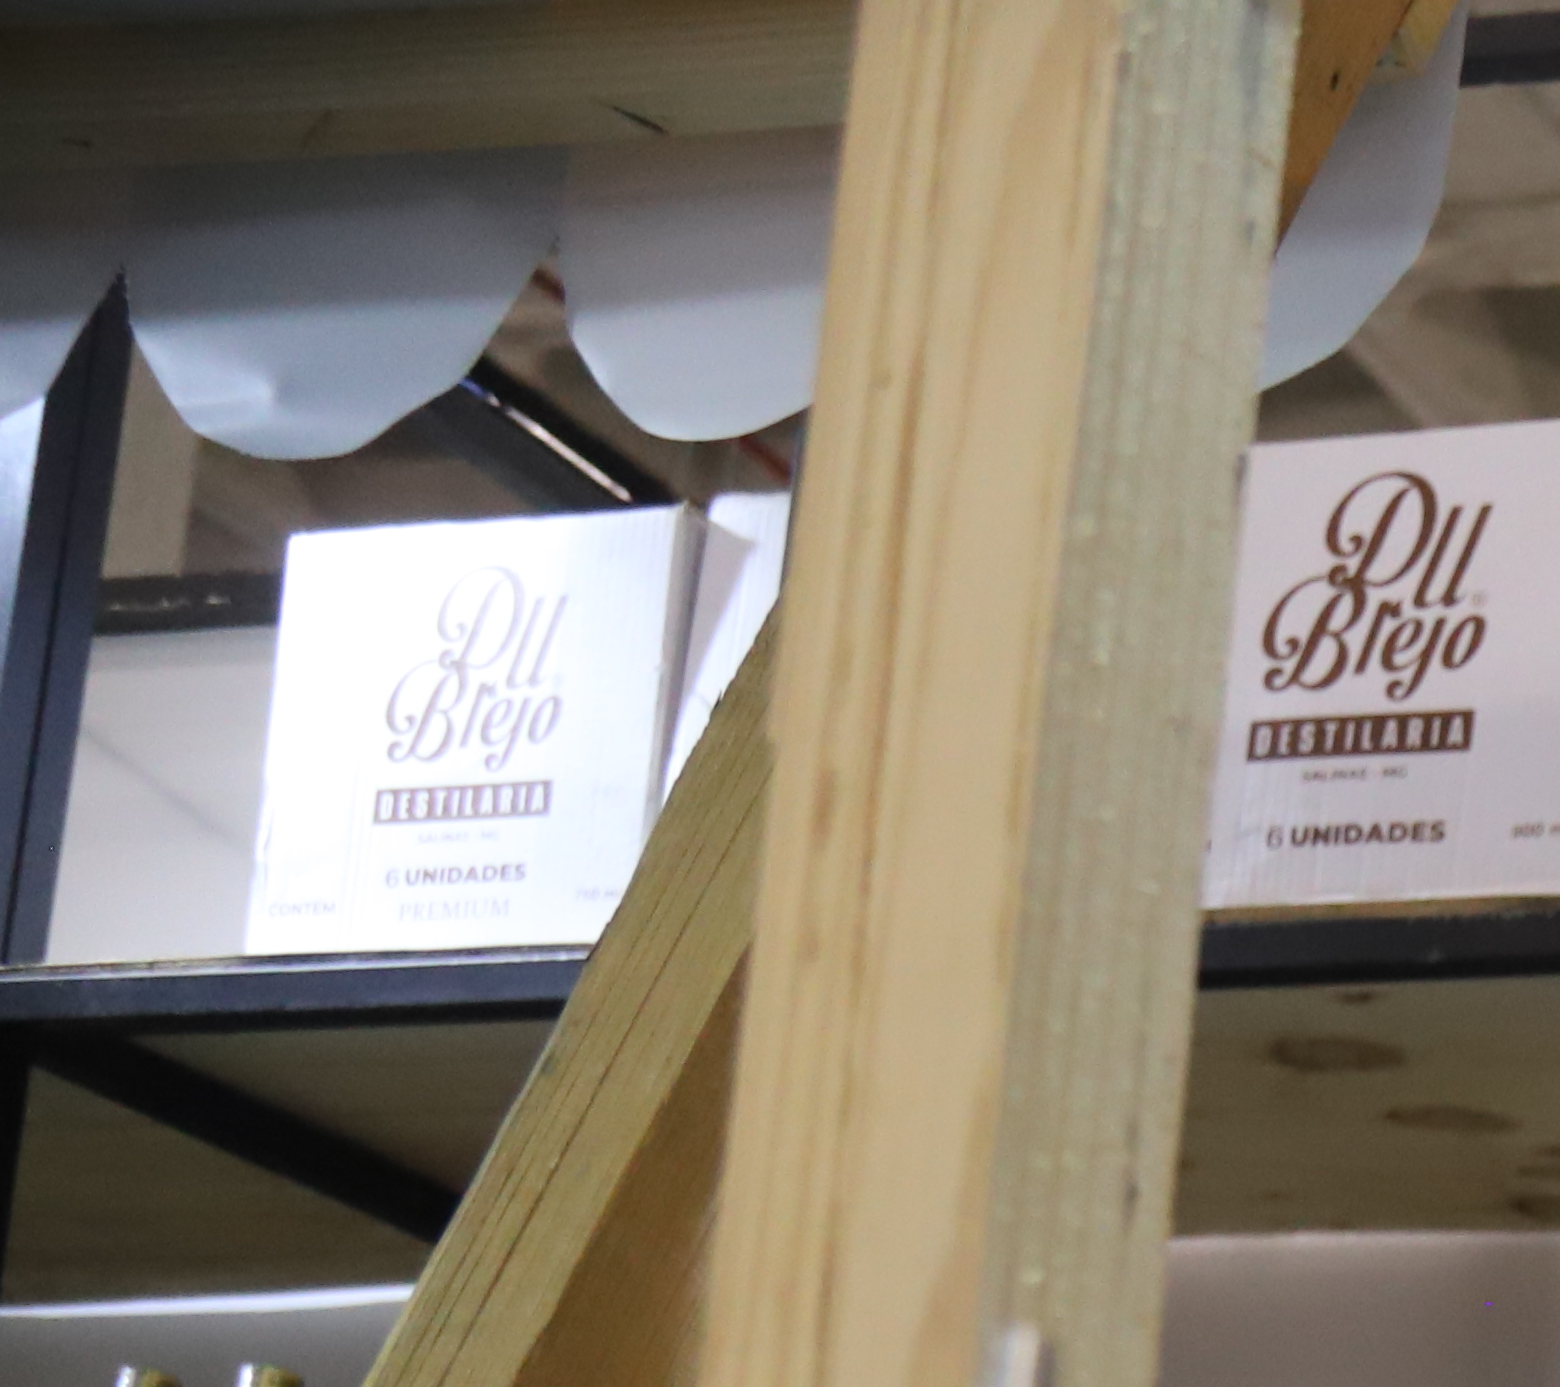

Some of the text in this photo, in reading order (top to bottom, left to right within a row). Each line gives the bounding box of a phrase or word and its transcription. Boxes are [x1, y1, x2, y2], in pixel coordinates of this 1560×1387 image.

[1262, 575, 1487, 700] Brejo
[1252, 714, 1468, 758] DESTILARIA
[377, 782, 547, 822] DESTILARIA
[1290, 819, 1446, 847] UNIDADES
[404, 862, 527, 887] UNIDADES
